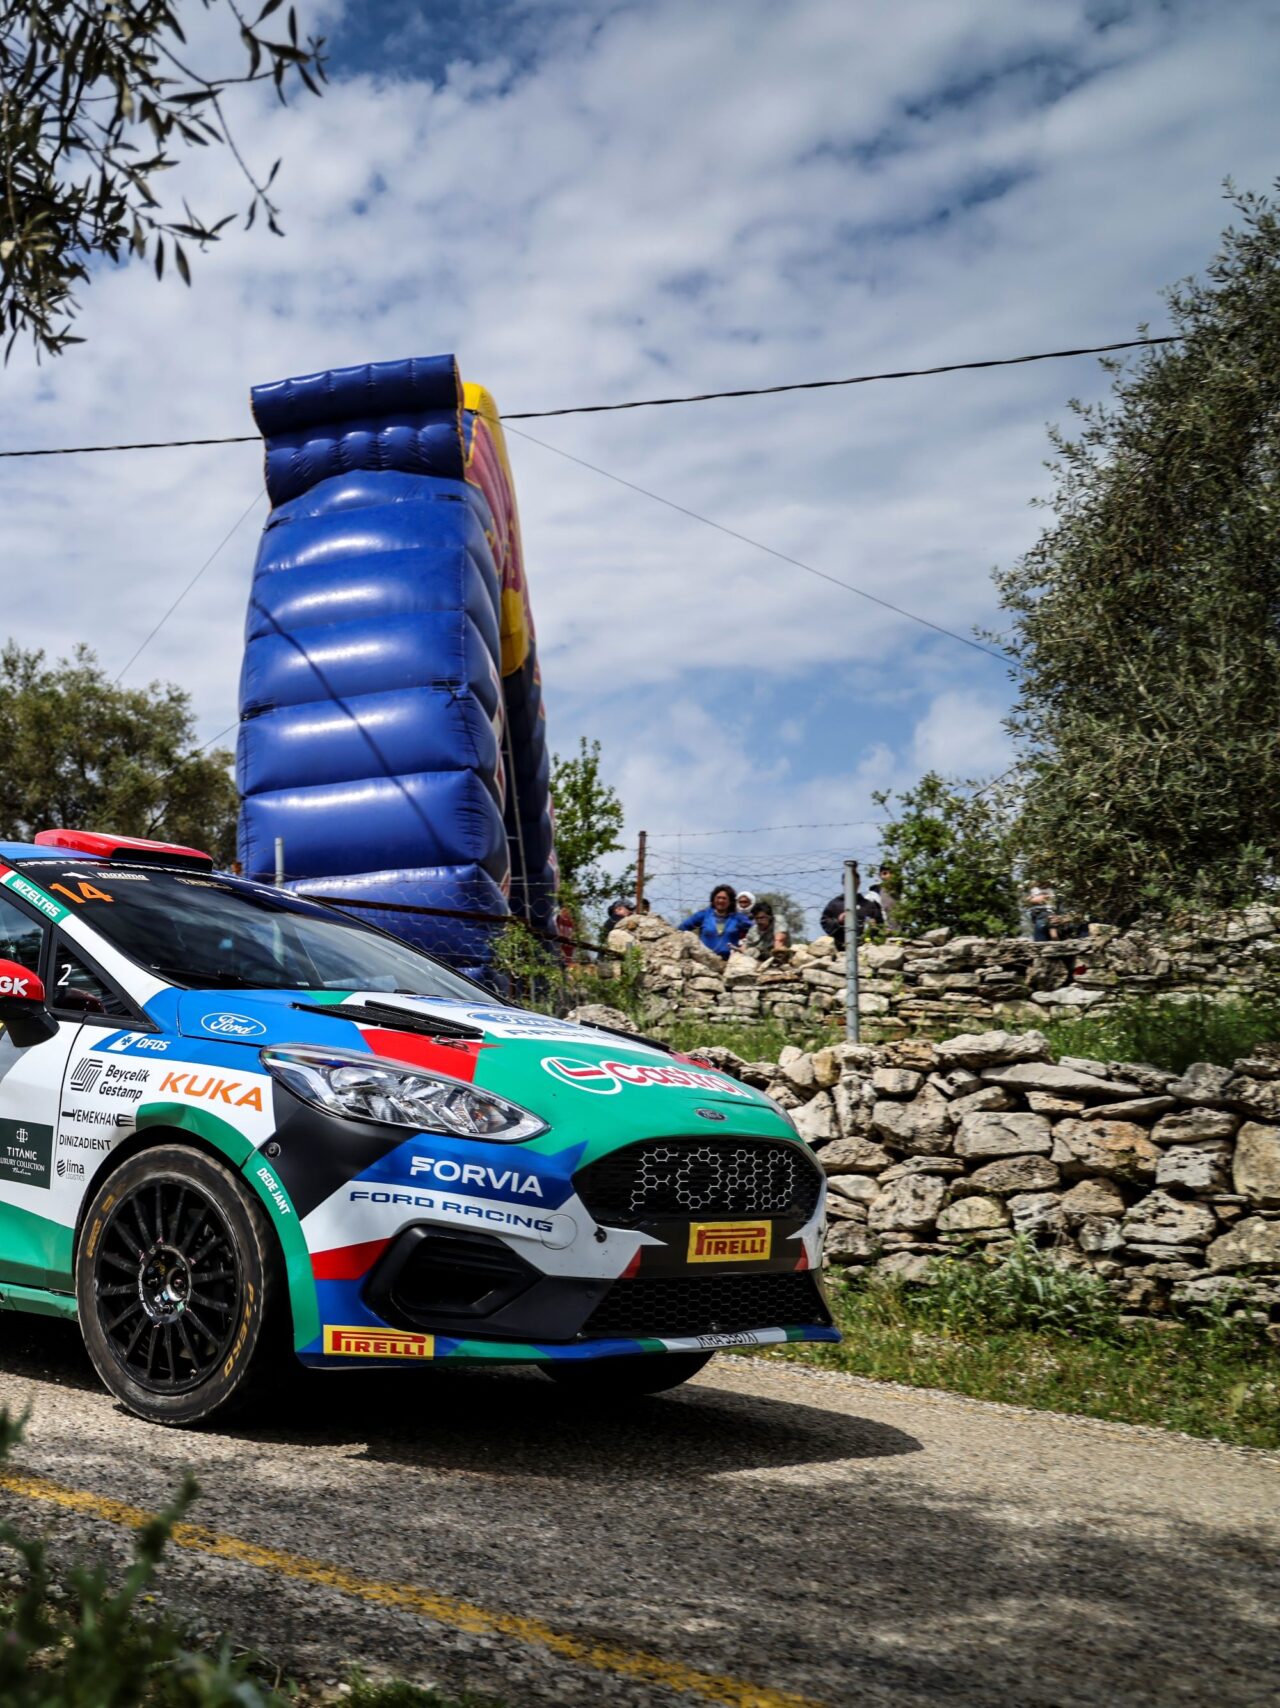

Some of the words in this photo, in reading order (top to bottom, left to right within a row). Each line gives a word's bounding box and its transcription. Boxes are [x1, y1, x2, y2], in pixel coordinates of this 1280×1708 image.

[48, 882, 115, 904] 14
[57, 963, 72, 986] 2
[209, 1014, 257, 1035] Ford
[105, 1064, 150, 1083] Beyçelik
[600, 1060, 754, 1100] Castrol
[99, 1081, 143, 1103] Gestamp
[159, 1071, 263, 1112] KUKA
[6, 1146, 37, 1160] TITANIC
[16, 1159, 45, 1172] COLLECTION
[66, 1158, 85, 1174] lima
[410, 1155, 544, 1198] FORVIA
[256, 1167, 278, 1193] DEDE
[271, 1187, 291, 1215] JANT
[350, 1190, 434, 1209] FORD
[442, 1200, 553, 1233] RACING
[695, 1228, 767, 1256] PIRELLI
[331, 1330, 427, 1356] PIRELLI
